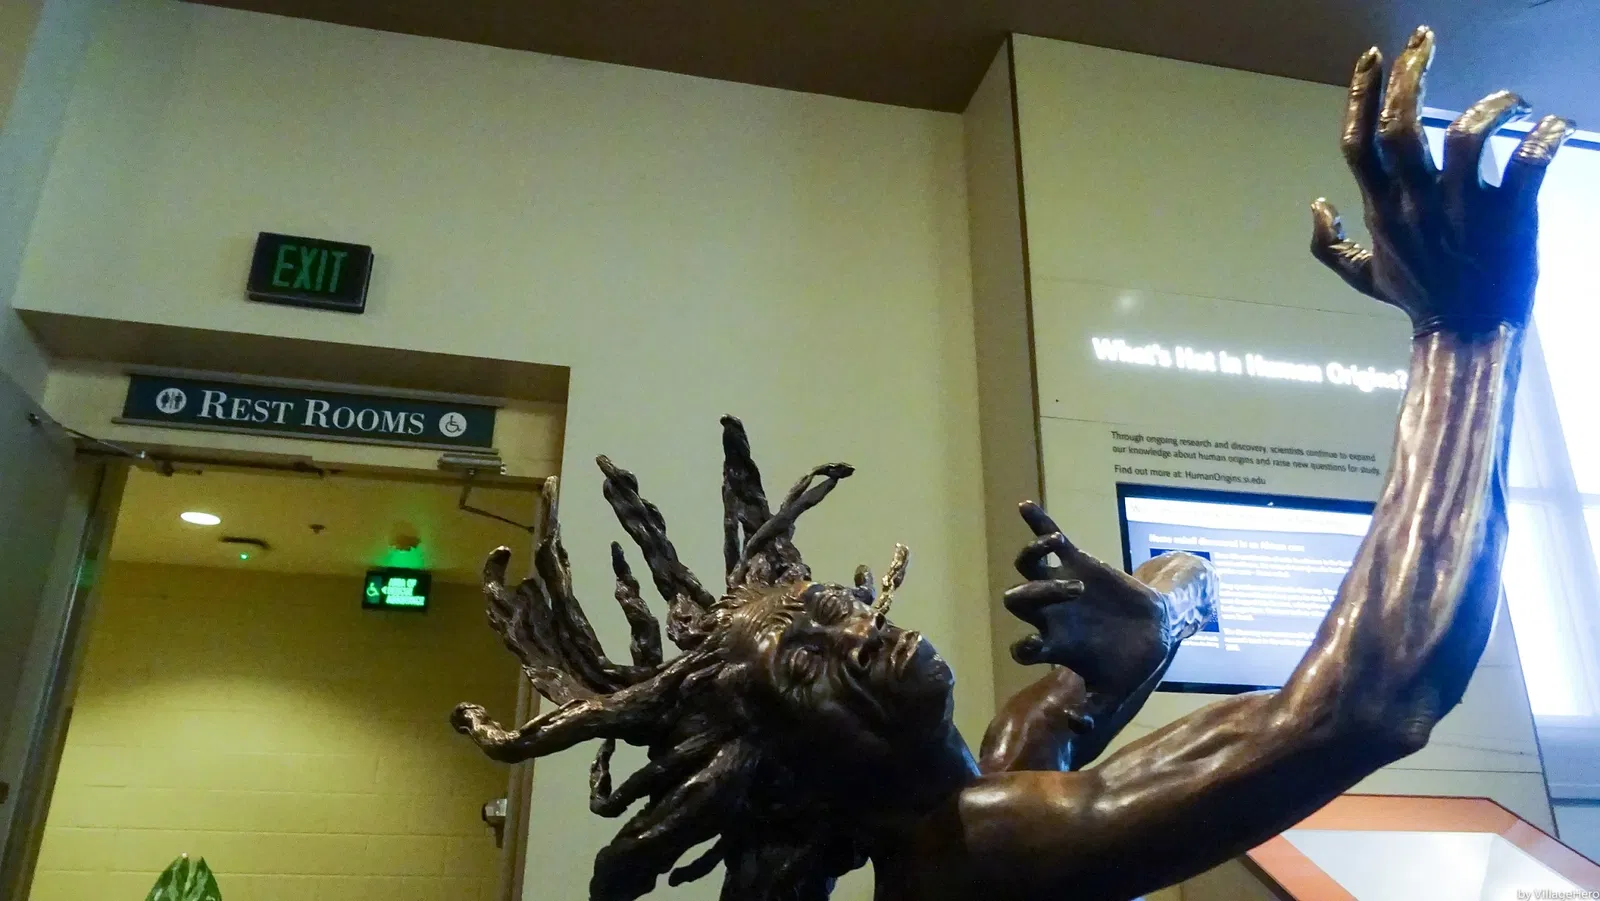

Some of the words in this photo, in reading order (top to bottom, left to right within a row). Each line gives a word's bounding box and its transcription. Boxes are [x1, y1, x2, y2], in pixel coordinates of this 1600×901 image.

[272, 243, 348, 293] EXIT
[1092, 337, 1172, 367] What's
[1245, 352, 1323, 383] Human
[1326, 361, 1408, 392] Origins?
[197, 389, 294, 424] REST
[301, 399, 425, 436] ROOMS
[1111, 431, 1144, 442] Through
[1146, 435, 1177, 447] ongoing
[1179, 438, 1211, 448] research
[1214, 441, 1228, 449] and
[1270, 445, 1304, 456] scientists
[1306, 449, 1337, 459] continue
[1339, 452, 1347, 460] to
[1349, 453, 1376, 463] expand
[1112, 445, 1125, 453] our
[1128, 446, 1171, 459] knowledge
[1173, 450, 1196, 459] about
[1198, 452, 1226, 462] human
[1228, 455, 1254, 466] origins
[1256, 457, 1270, 466] and
[1272, 459, 1291, 468] raise
[1310, 462, 1346, 473] questions
[1348, 464, 1358, 473] for
[1114, 465, 1132, 475] Find
[1134, 468, 1148, 476] out
[1150, 469, 1170, 478] more
